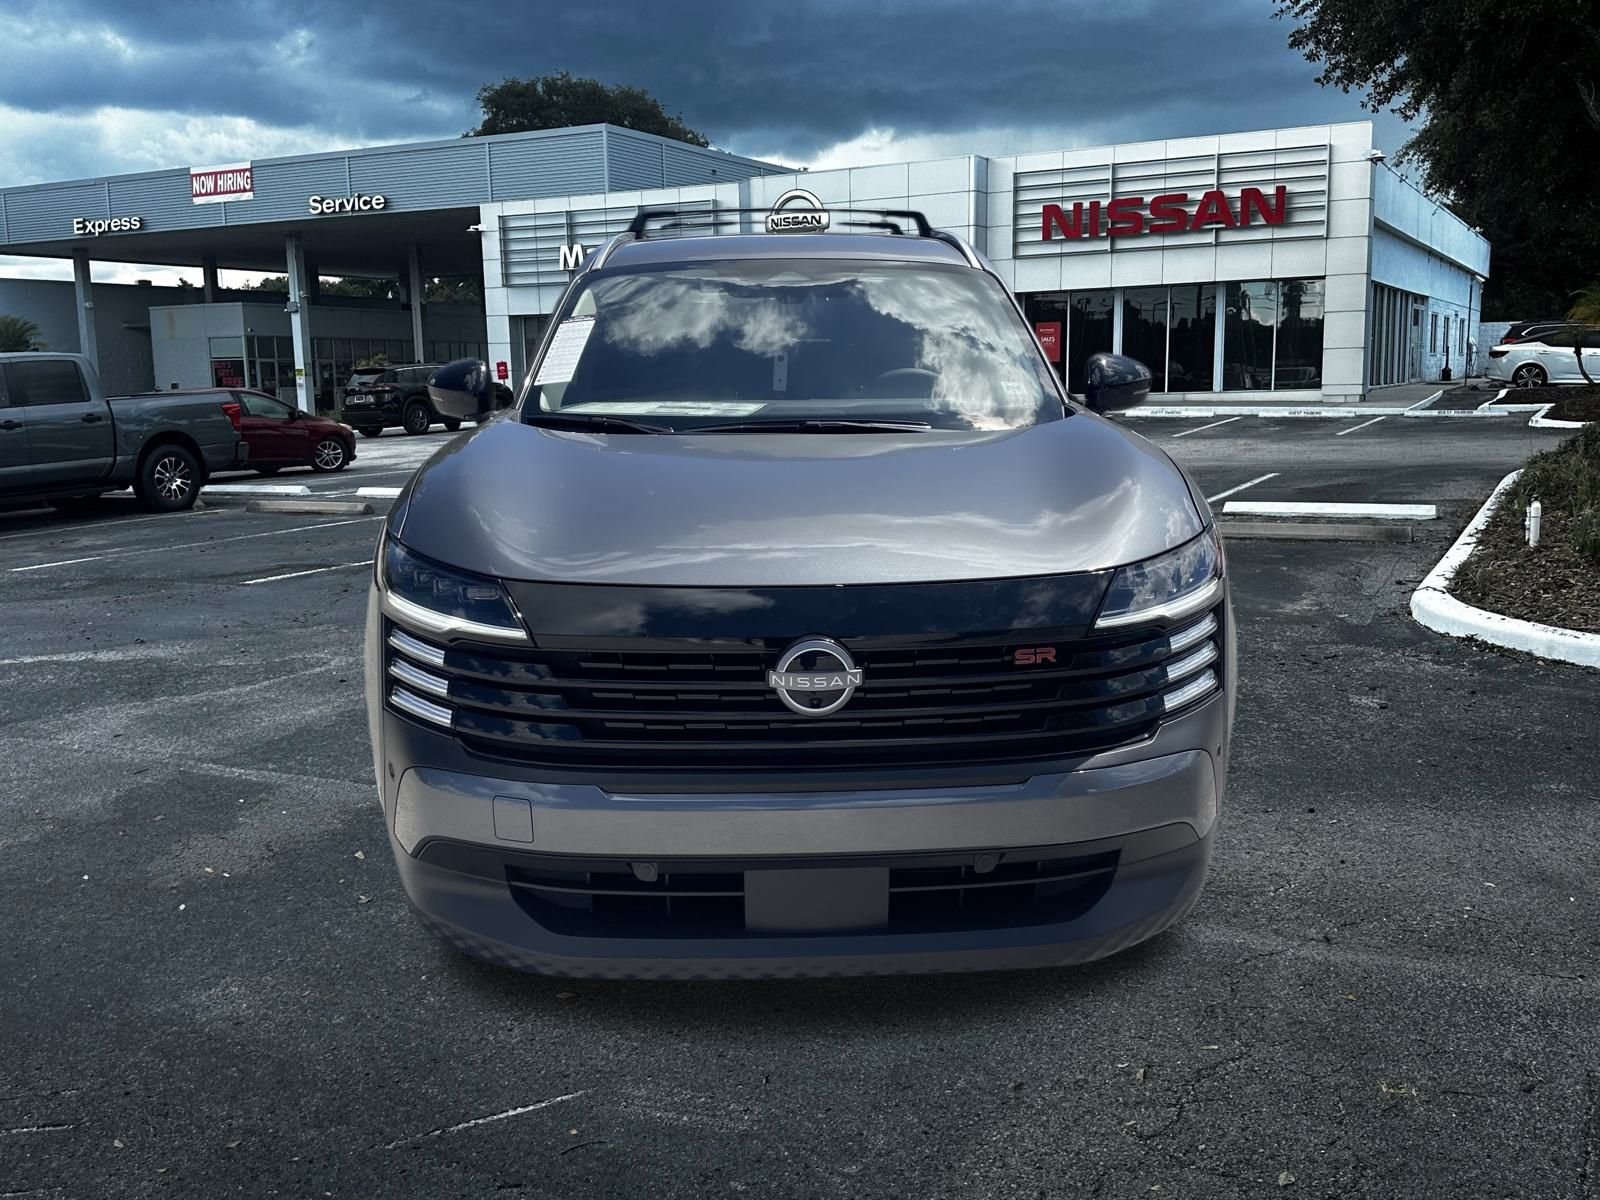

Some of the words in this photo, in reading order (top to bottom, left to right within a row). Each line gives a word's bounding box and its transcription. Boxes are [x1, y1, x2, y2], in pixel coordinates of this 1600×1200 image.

[192, 174, 215, 195] NOW
[216, 171, 251, 193] HIRING
[308, 193, 385, 215] Service
[1042, 185, 1287, 241] NISSAN
[73, 216, 141, 237] Express
[770, 215, 822, 228] NISSAN
[560, 243, 597, 271] M
[1014, 647, 1057, 665] SR
[771, 673, 861, 688] NISSAN
